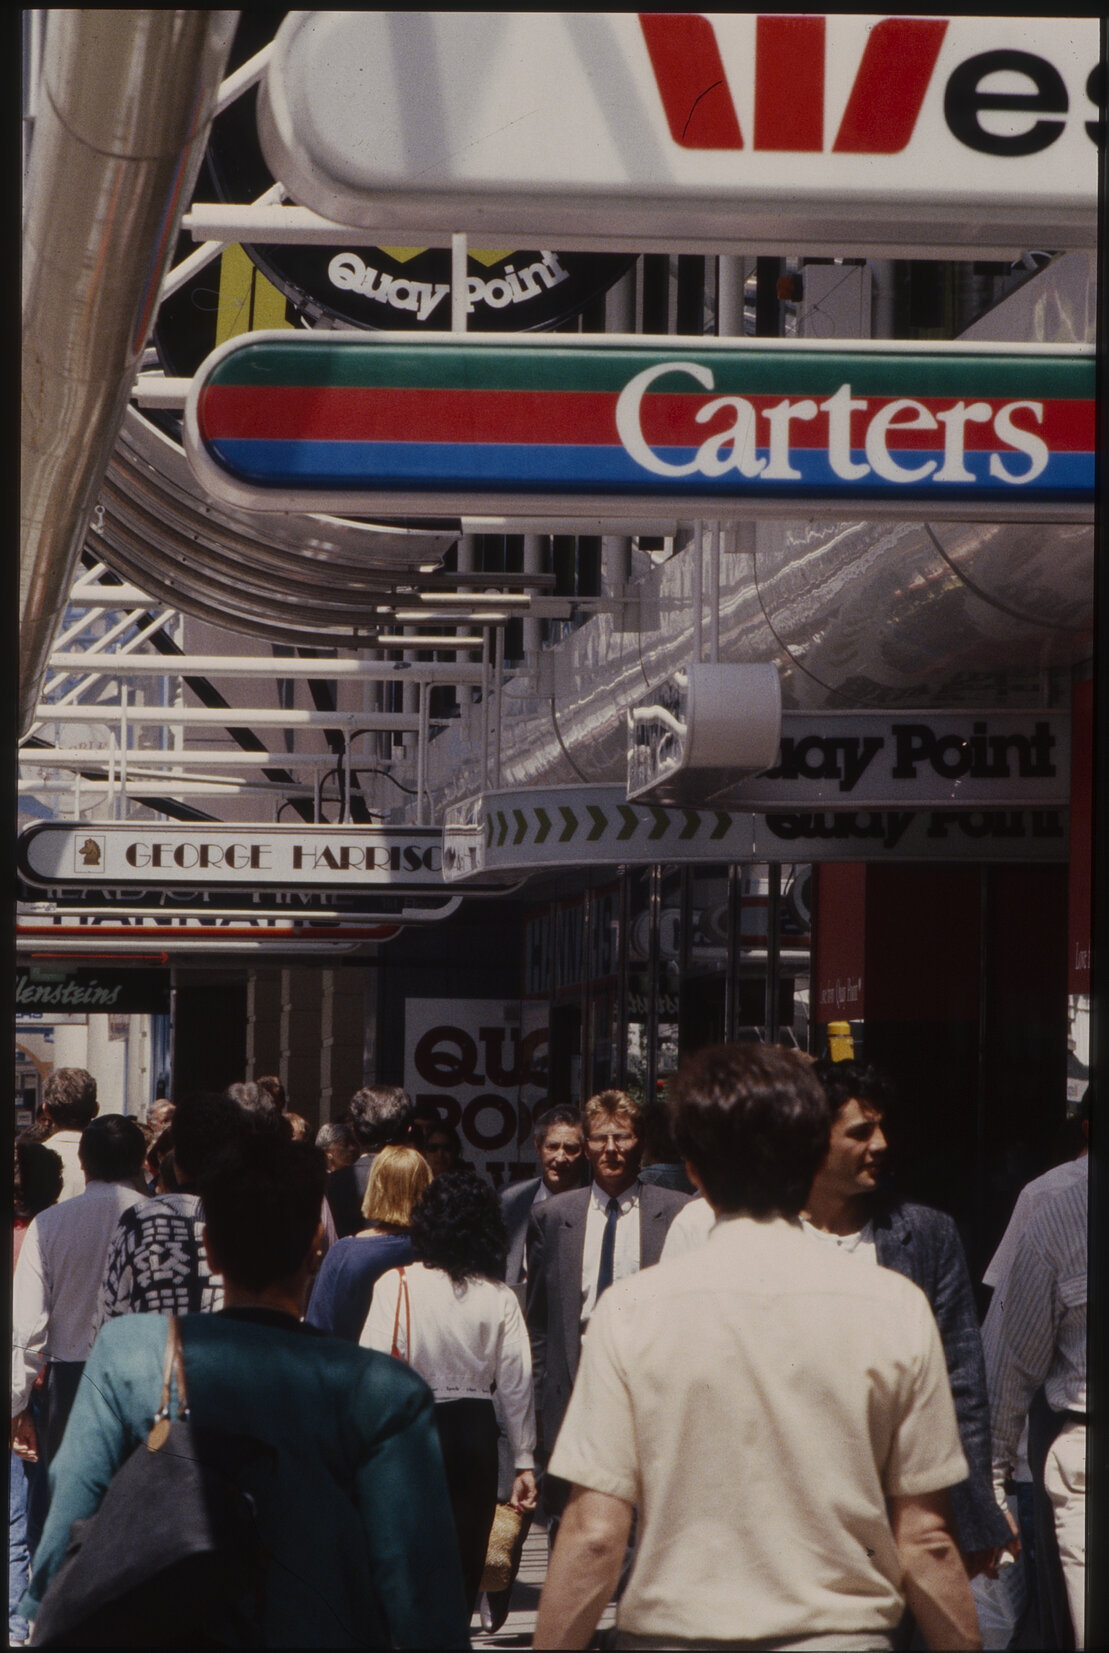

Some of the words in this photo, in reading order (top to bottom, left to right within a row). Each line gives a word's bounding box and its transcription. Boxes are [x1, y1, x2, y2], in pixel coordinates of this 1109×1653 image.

[327, 252, 450, 321] Quay
[466, 250, 571, 314] Point
[615, 361, 1050, 486] Carters
[756, 735, 885, 792] uay
[891, 721, 1057, 780] Point
[125, 842, 273, 870] GEORGE
[292, 844, 444, 872] HARRISO
